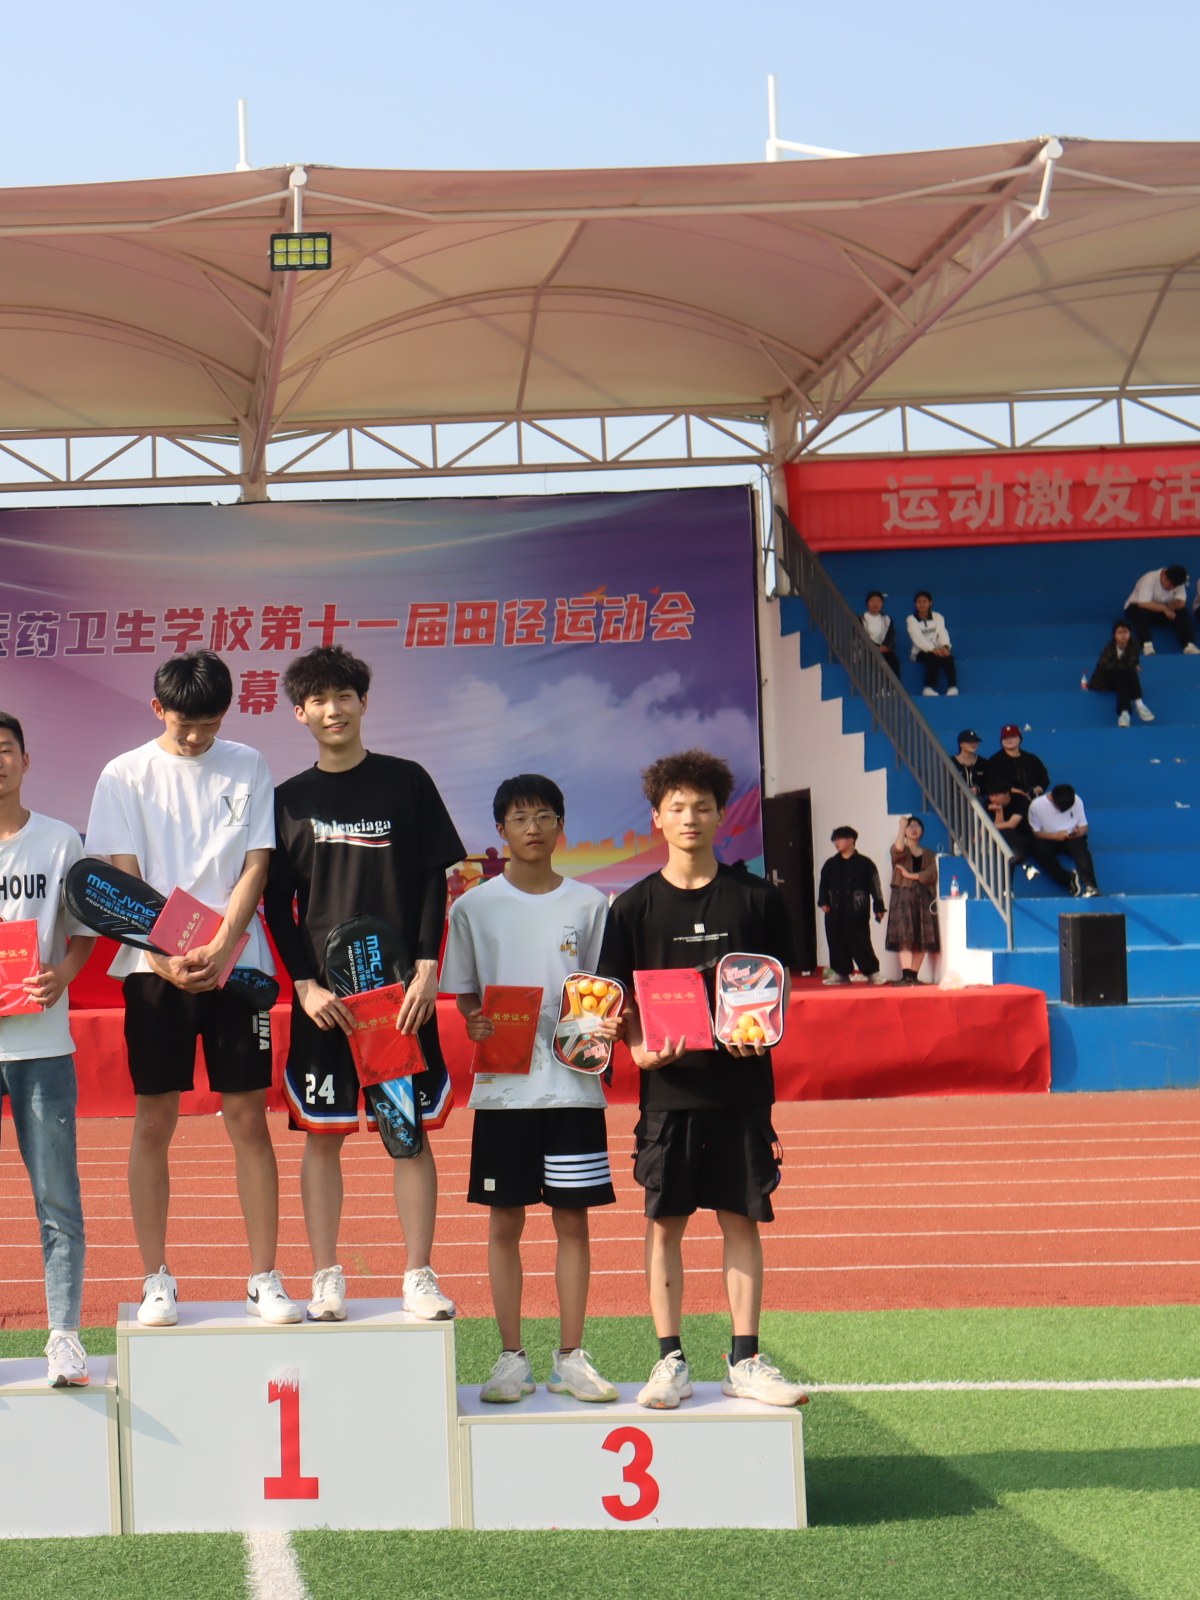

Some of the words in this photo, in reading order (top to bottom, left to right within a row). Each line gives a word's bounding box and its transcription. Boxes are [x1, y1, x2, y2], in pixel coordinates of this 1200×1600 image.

[881, 462, 1200, 532] 运动激发活
[236, 669, 281, 716] 幕
[85, 896, 129, 921] PROFESSIONAL
[177, 912, 200, 950] 荣誉证书
[347, 945, 359, 993] PROFESSIONAL
[491, 1012, 530, 1022] 荣誉证书
[305, 1073, 335, 1105] 24
[264, 1370, 318, 1499] 1
[602, 1426, 659, 1521] 3
